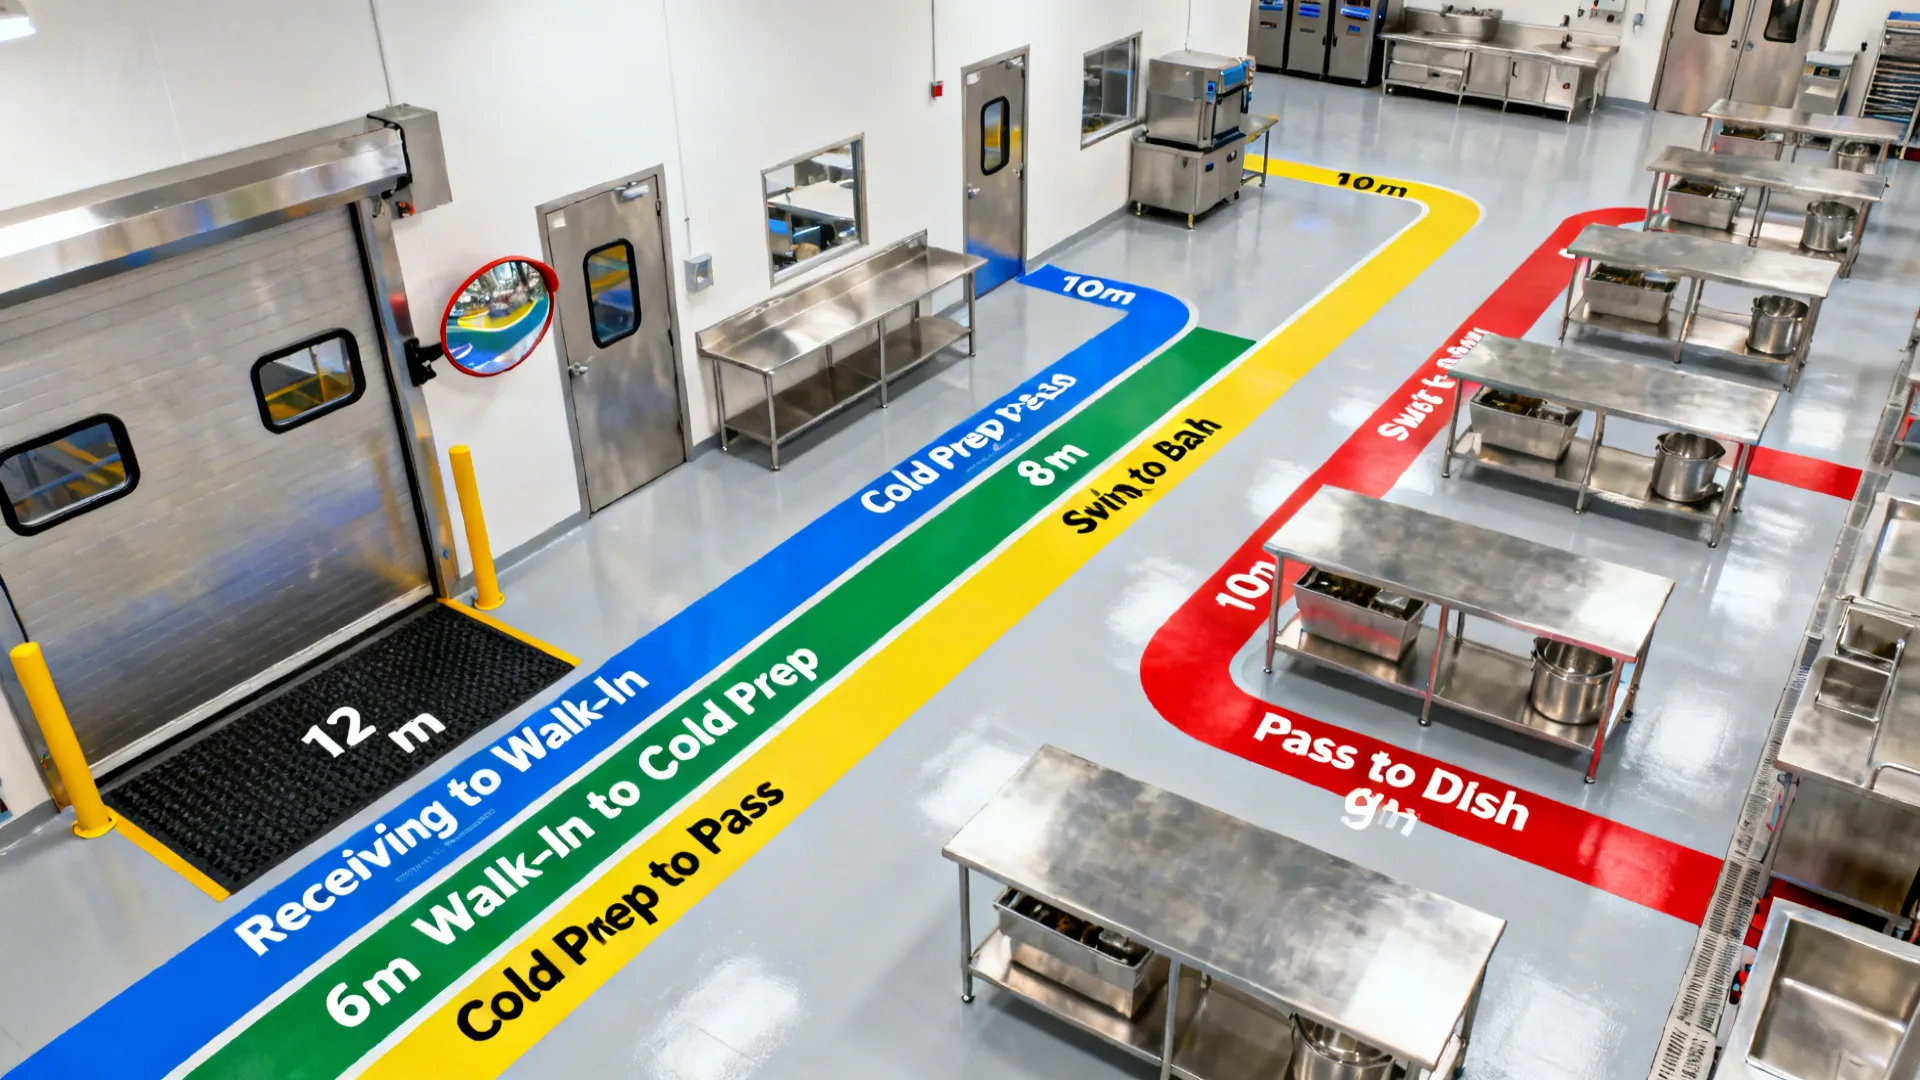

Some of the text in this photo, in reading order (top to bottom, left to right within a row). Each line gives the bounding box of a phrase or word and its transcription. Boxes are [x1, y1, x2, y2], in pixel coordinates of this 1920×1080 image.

[1337, 172, 1408, 198] 10m
[1062, 275, 1137, 305] 10m
[860, 460, 940, 514] Cold
[1128, 461, 1167, 485] to
[301, 705, 446, 758] 12 m
[1253, 711, 1530, 832] Pass to Dish
[233, 799, 459, 957] Receiving
[446, 767, 503, 808] to
[489, 669, 650, 775] Walk-In
[325, 956, 422, 1029] 6m
[410, 812, 597, 946] Walk-In
[587, 780, 641, 820] to
[637, 698, 739, 781] Cold
[722, 647, 819, 717] Prep
[455, 947, 567, 1042] Cold
[647, 850, 701, 888] to
[685, 781, 785, 856] Pass
